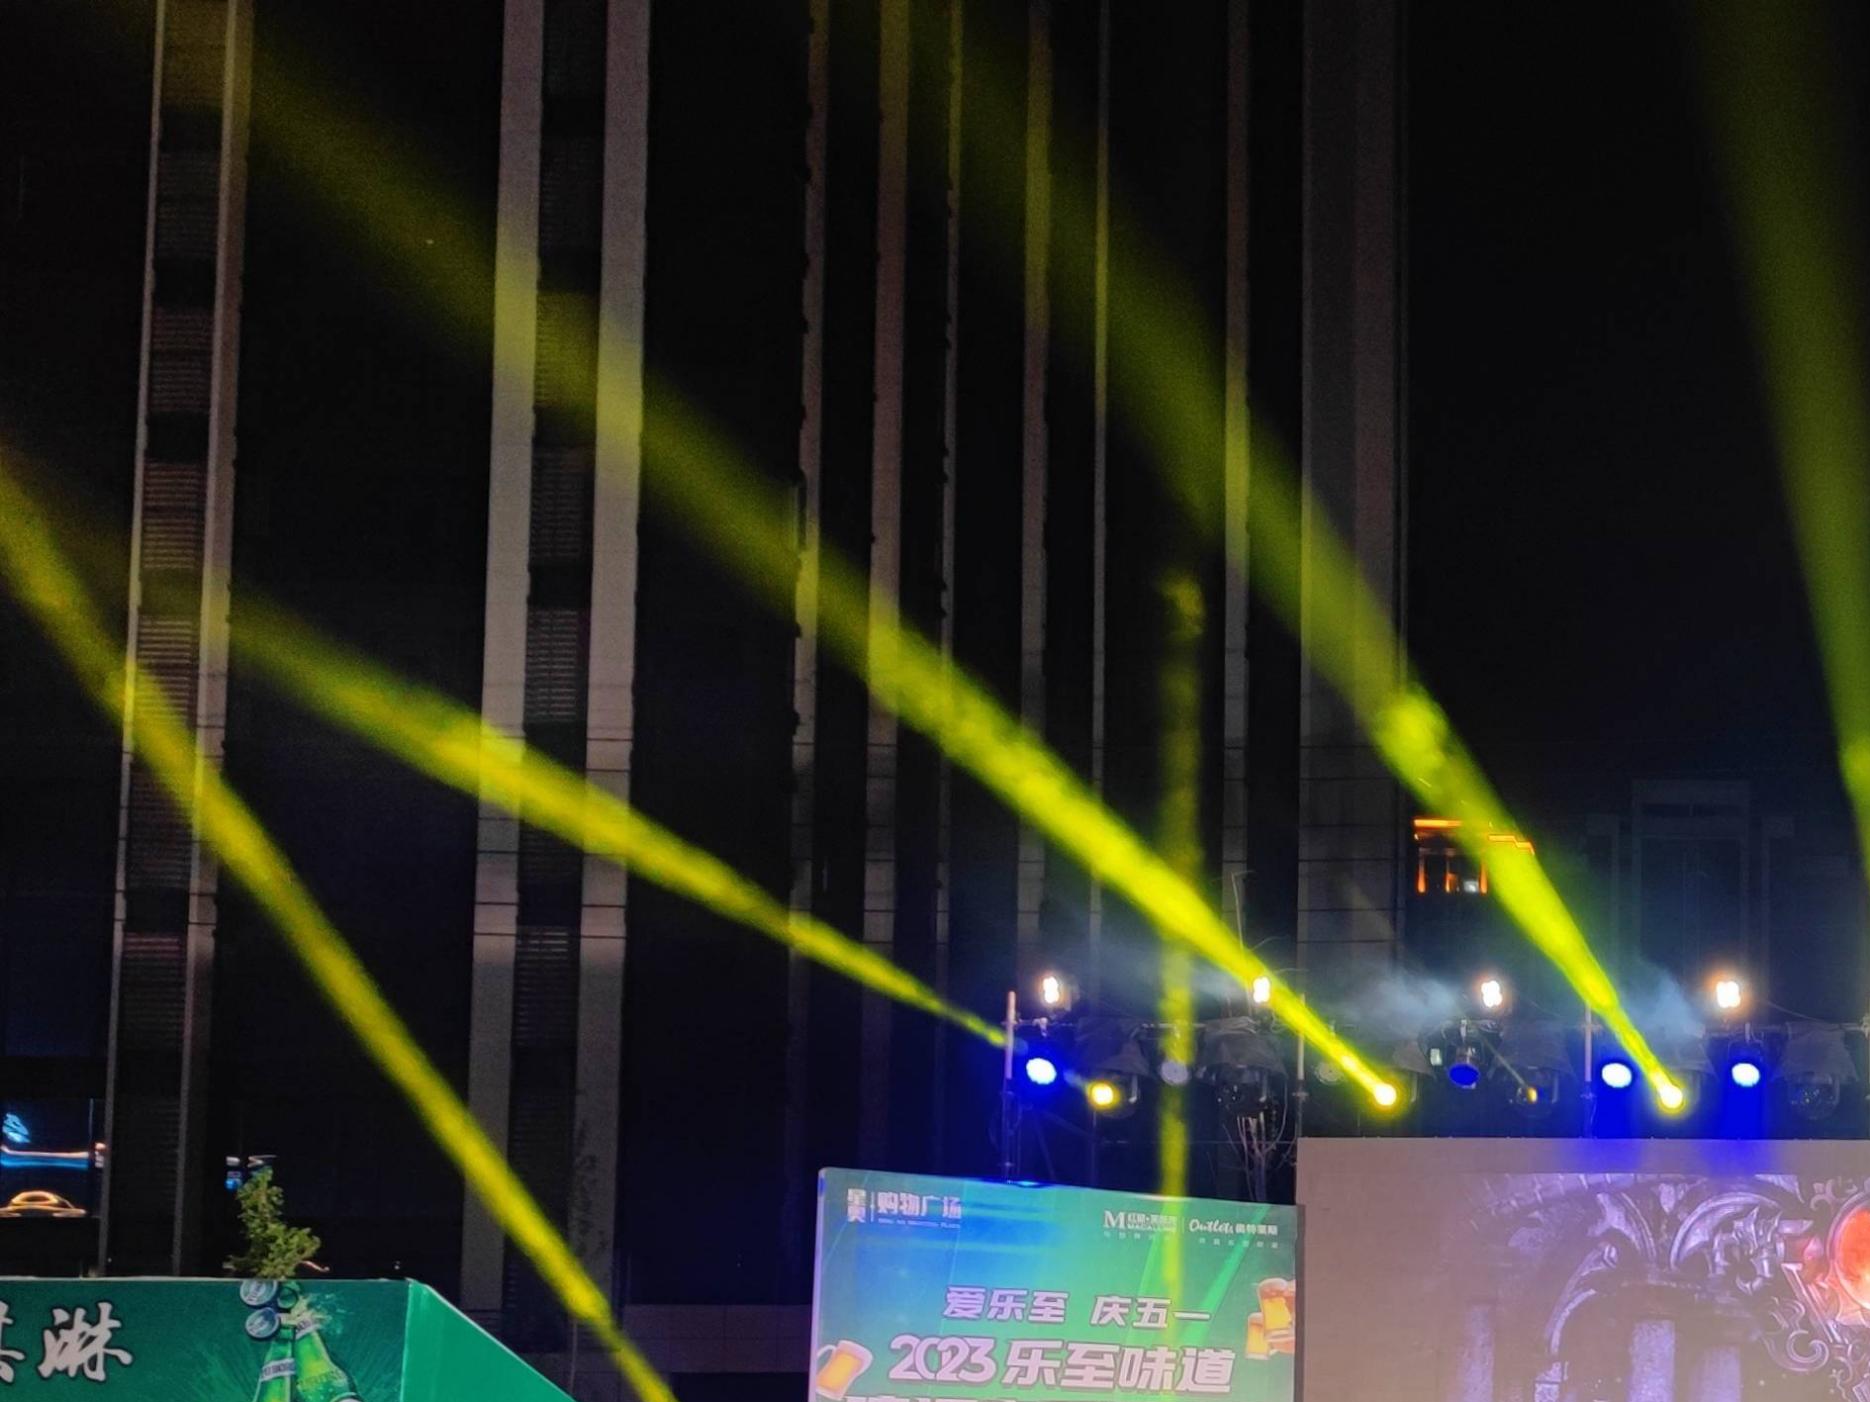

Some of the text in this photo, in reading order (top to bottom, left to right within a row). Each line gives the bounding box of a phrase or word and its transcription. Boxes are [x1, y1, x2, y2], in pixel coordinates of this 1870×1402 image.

[877, 1191, 961, 1219] 购物广场
[1189, 1219, 1234, 1234] Outlets
[944, 1286, 1211, 1329] 爱乐至 庆五一
